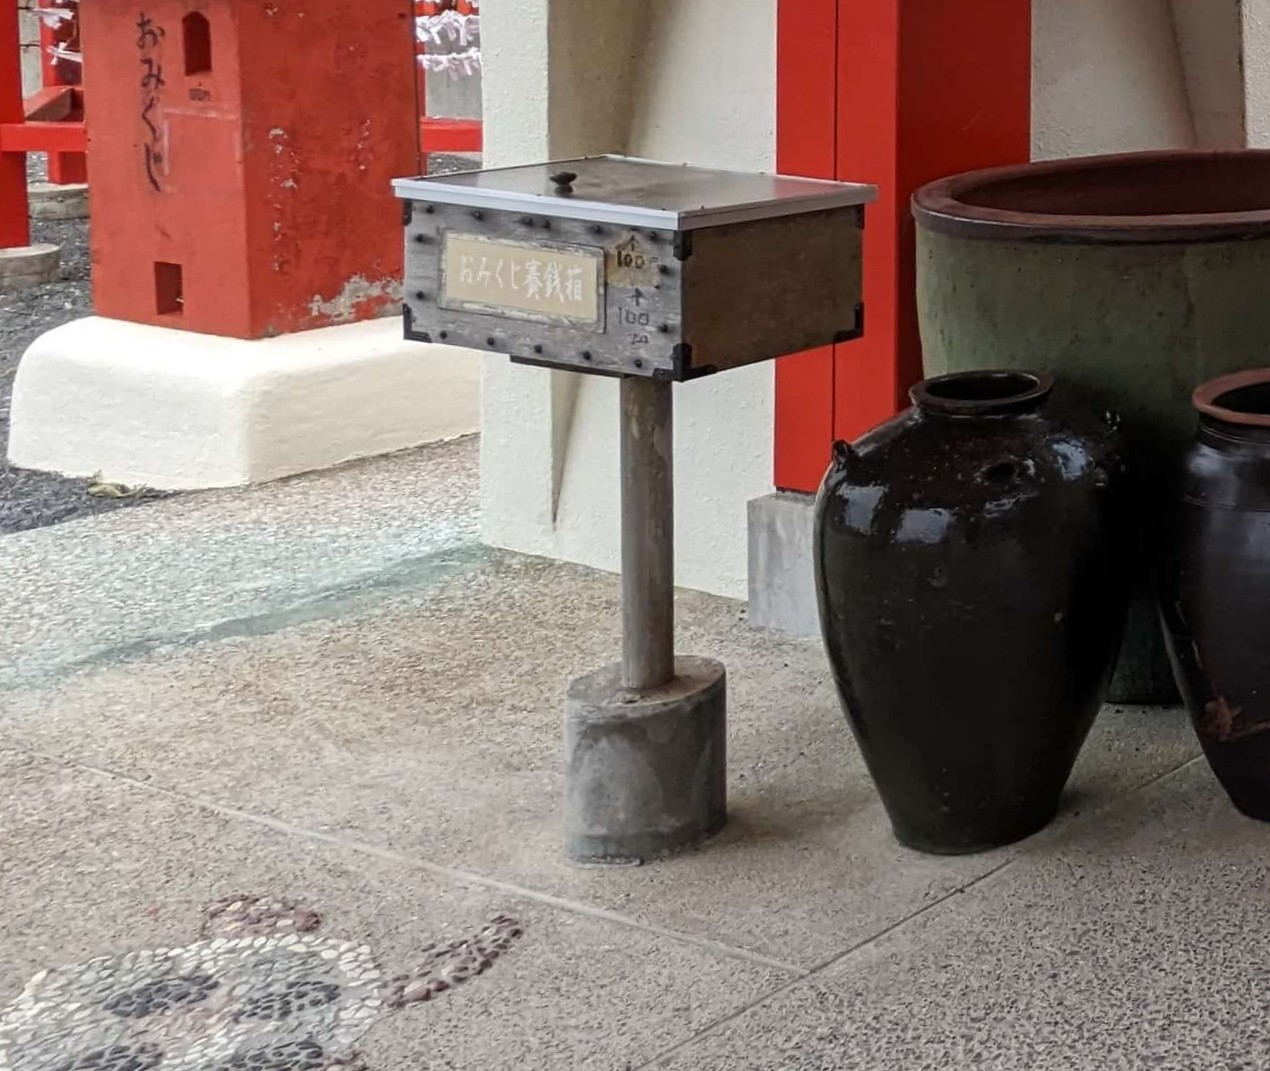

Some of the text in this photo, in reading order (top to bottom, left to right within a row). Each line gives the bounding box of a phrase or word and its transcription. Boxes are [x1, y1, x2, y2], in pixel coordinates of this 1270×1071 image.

[135, 11, 167, 192] おみくじ
[459, 255, 583, 303] おみくじ賽銭箱
